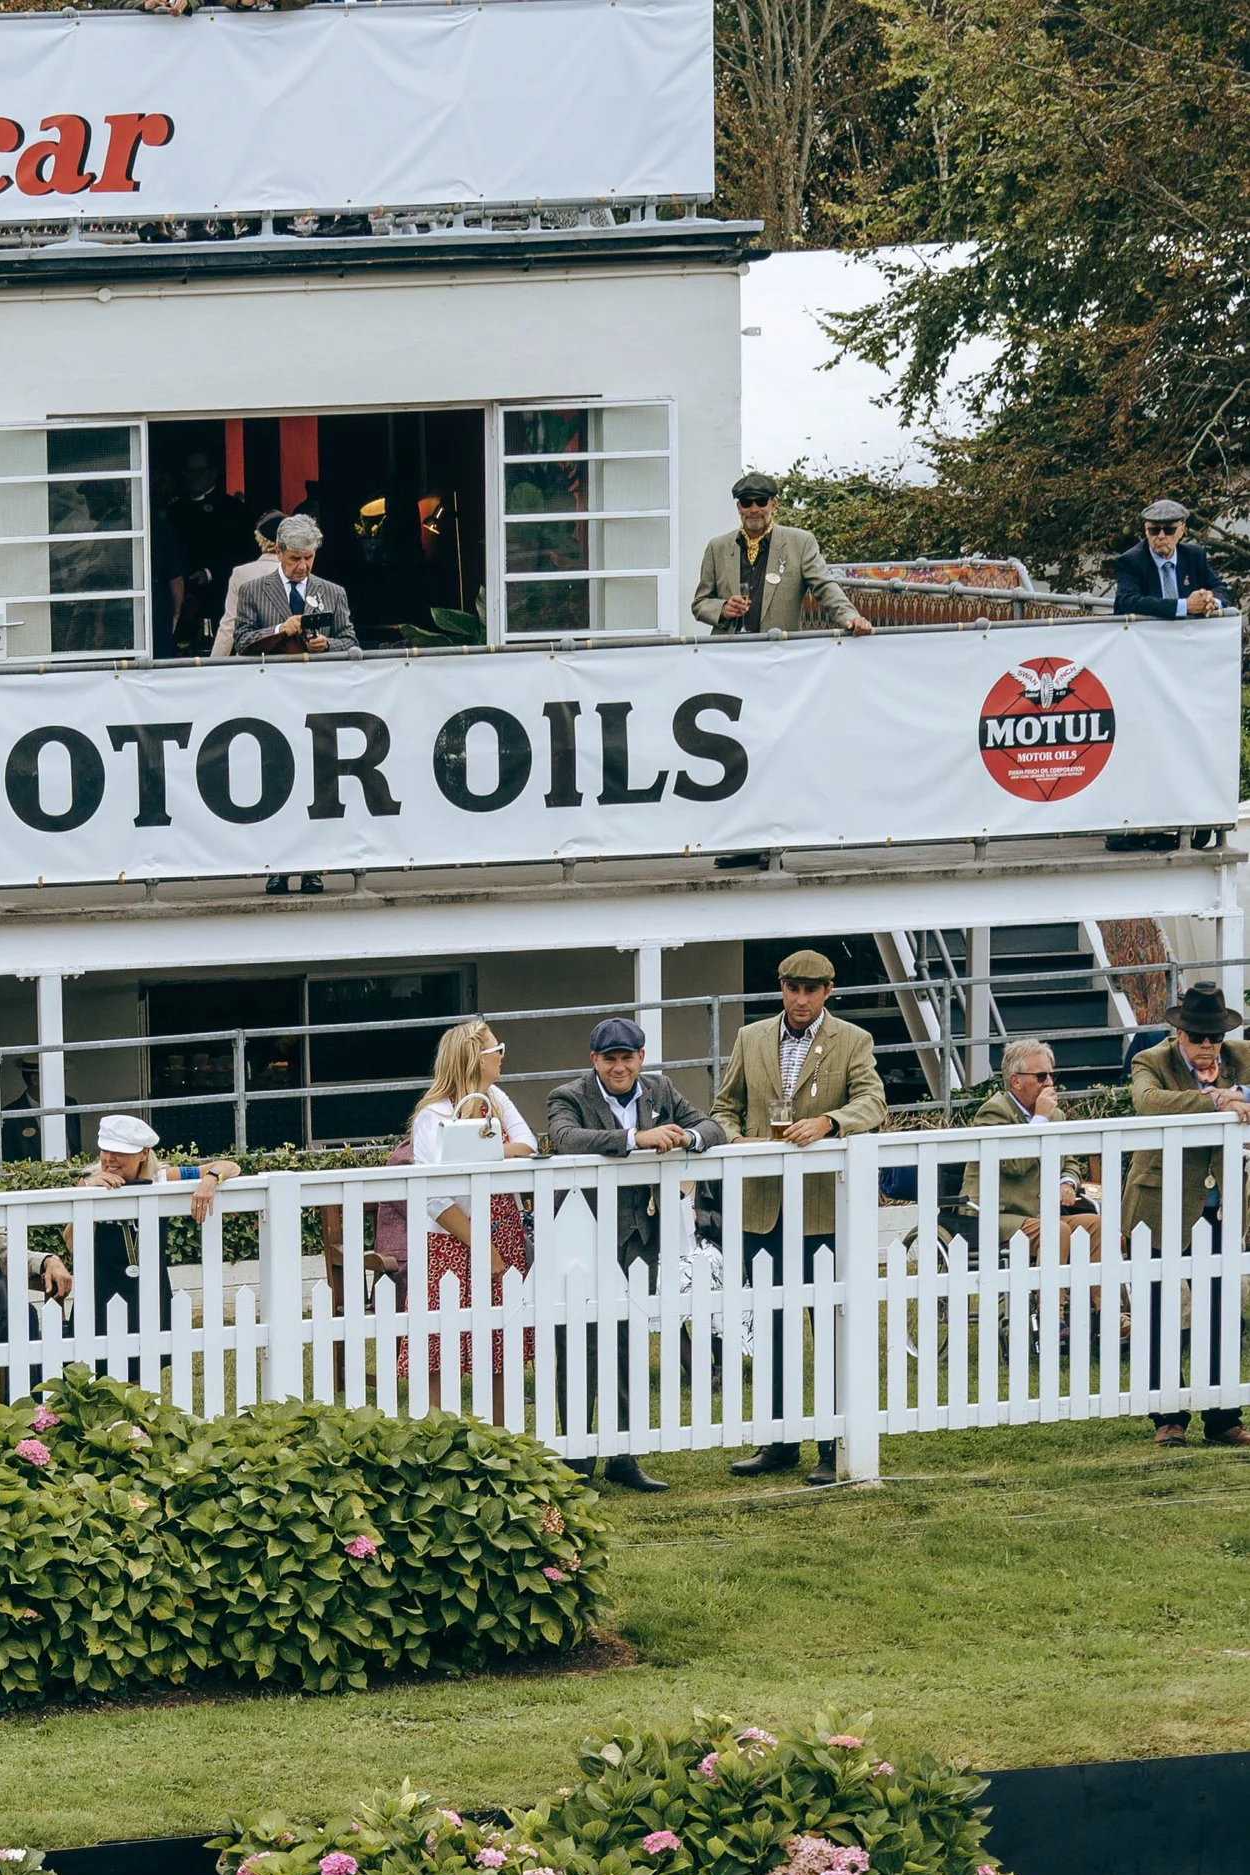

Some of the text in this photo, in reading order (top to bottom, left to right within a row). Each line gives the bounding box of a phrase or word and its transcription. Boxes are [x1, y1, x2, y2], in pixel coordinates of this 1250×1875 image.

[1017, 665, 1077, 687] SWAN FINCH
[986, 712, 1109, 747] MOTUL
[432, 692, 749, 813] OILS
[1017, 749, 1078, 763] MOTOR OILS
